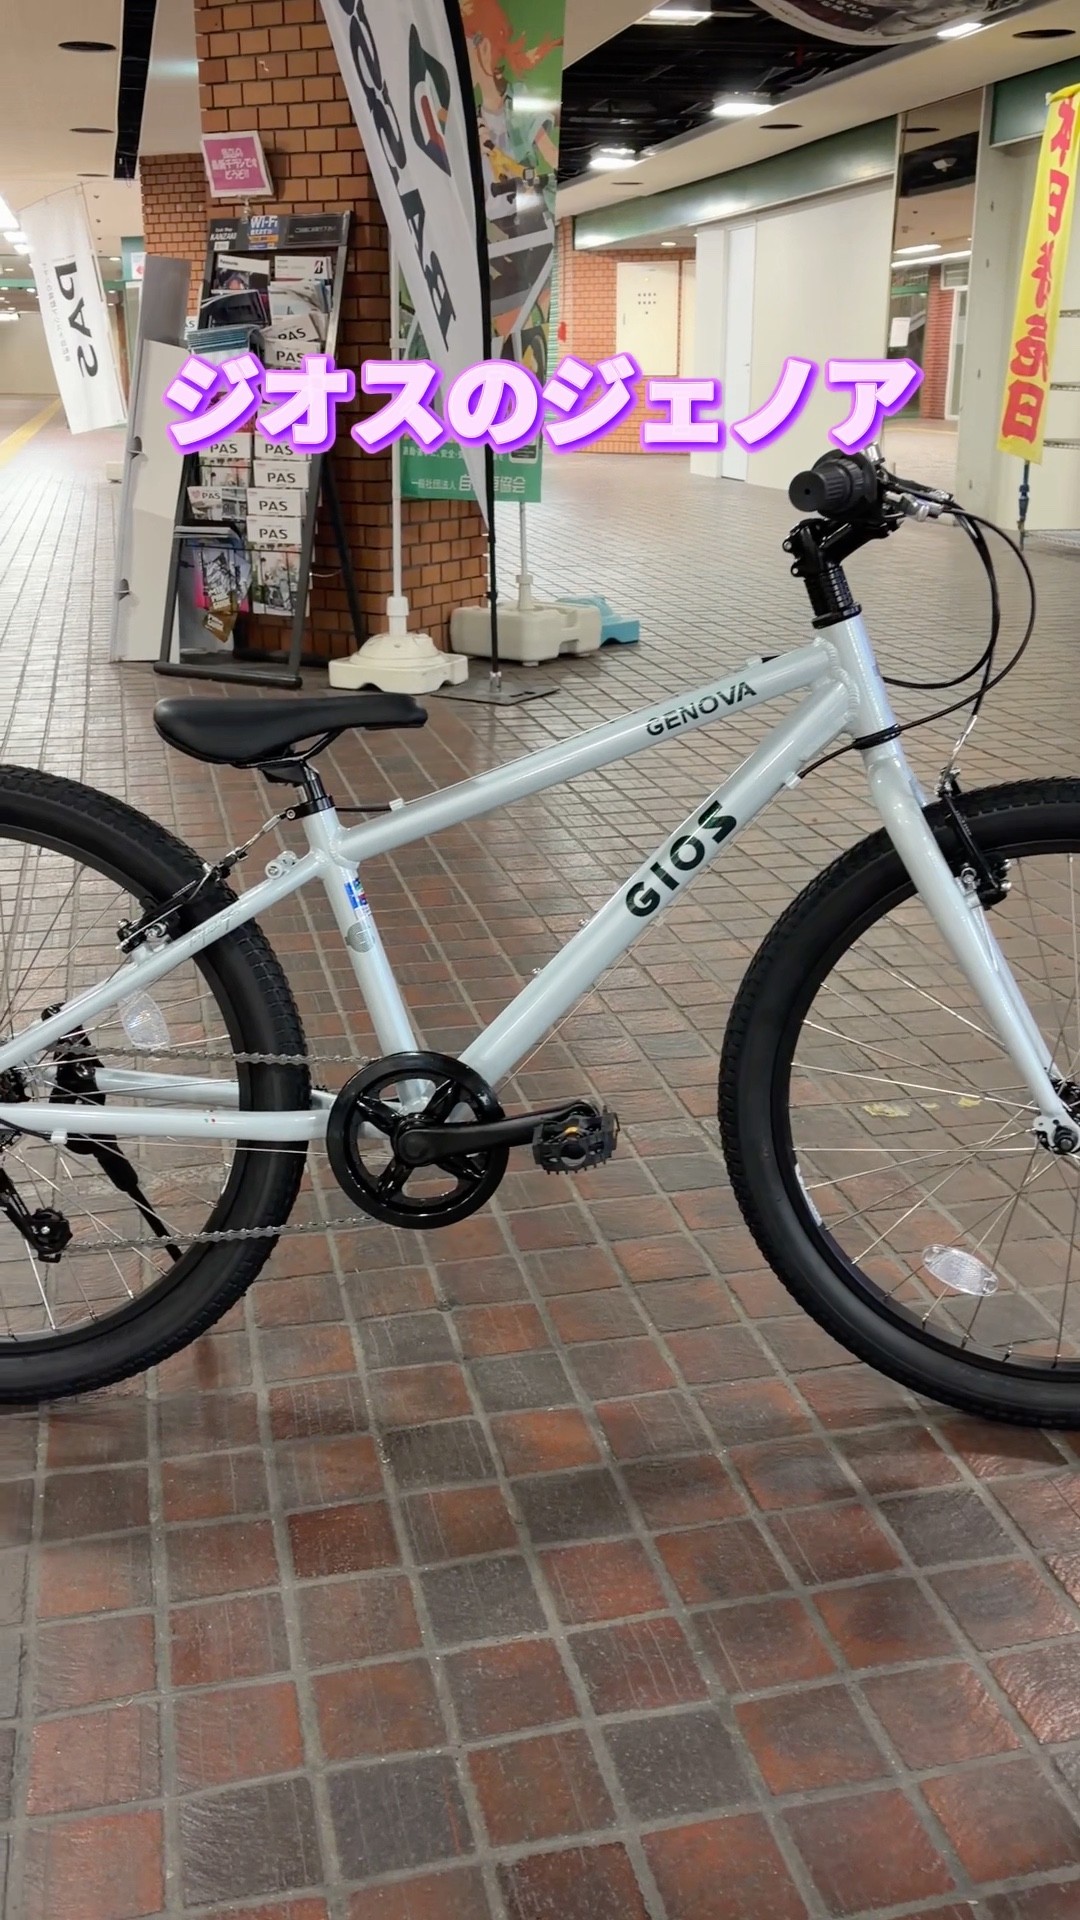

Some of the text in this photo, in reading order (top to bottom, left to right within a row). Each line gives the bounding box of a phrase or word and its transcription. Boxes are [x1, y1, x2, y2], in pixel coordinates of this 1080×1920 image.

[210, 443, 238, 454] PAS
[265, 443, 293, 455] PAS
[267, 472, 296, 484] PAS
[202, 492, 221, 500] PAS
[259, 500, 288, 512] PAS
[259, 528, 288, 540] PAS
[646, 681, 757, 737] GENOVA
[625, 800, 737, 917] GIOS
